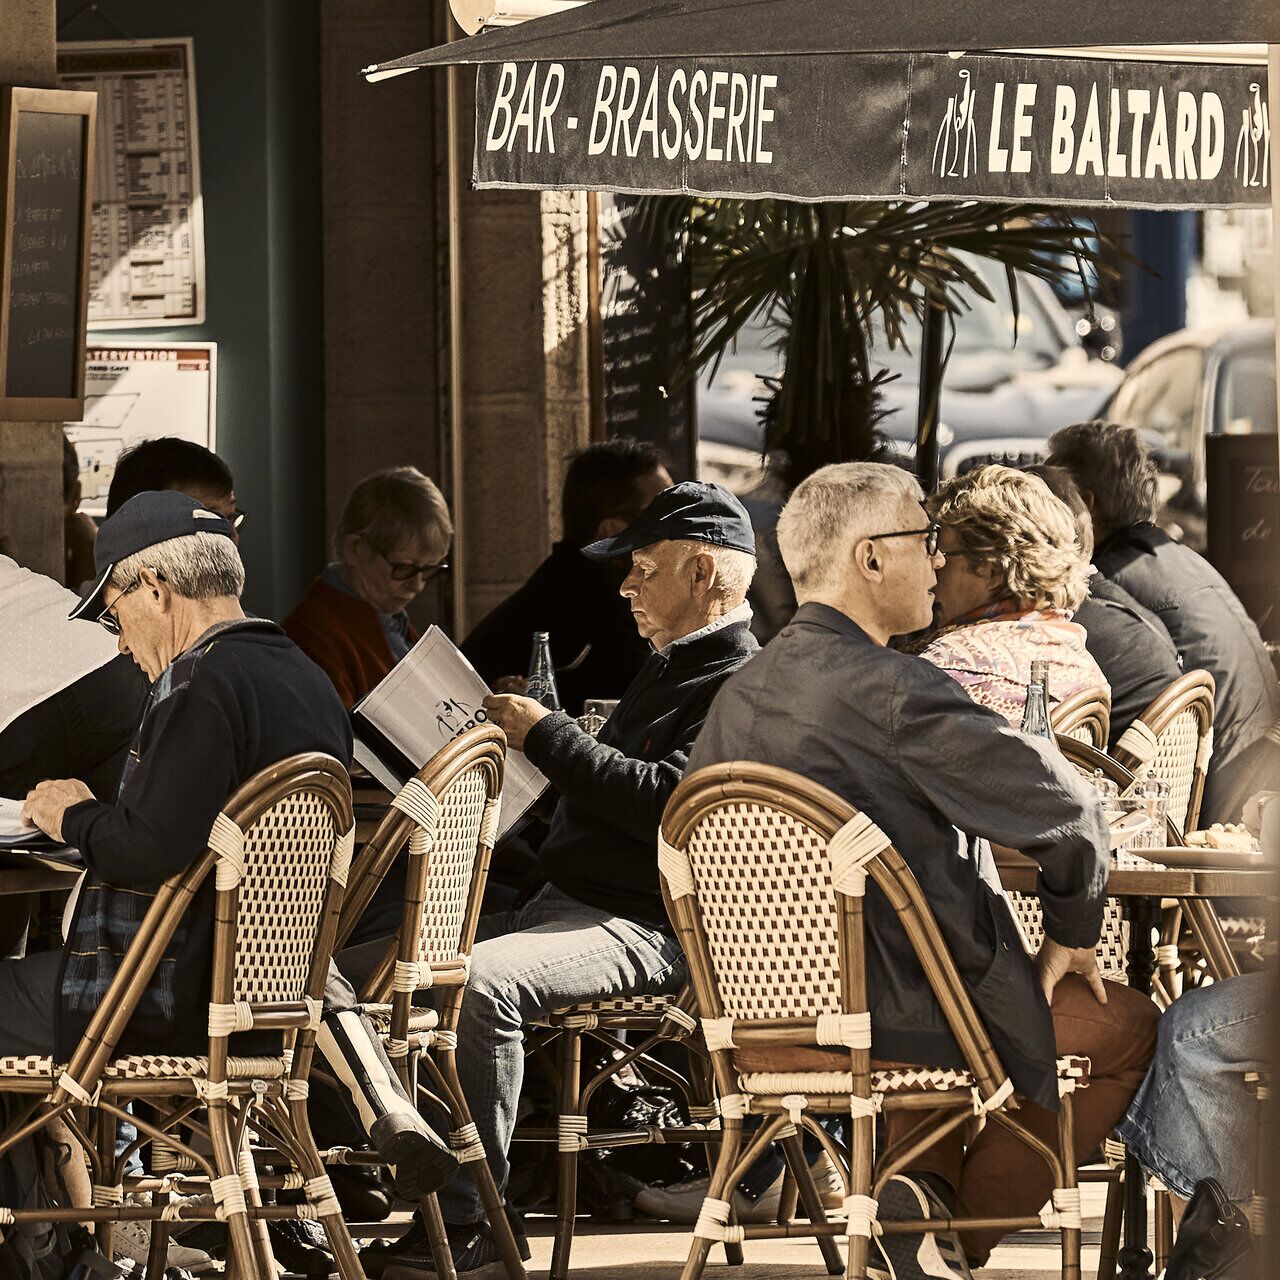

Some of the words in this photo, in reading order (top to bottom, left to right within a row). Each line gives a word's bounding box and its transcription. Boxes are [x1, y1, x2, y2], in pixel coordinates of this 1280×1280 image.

[486, 62, 566, 154] BAR
[588, 64, 778, 164] BRASSERIE
[988, 82, 1038, 173] LE
[1051, 81, 1226, 181] BALTARD
